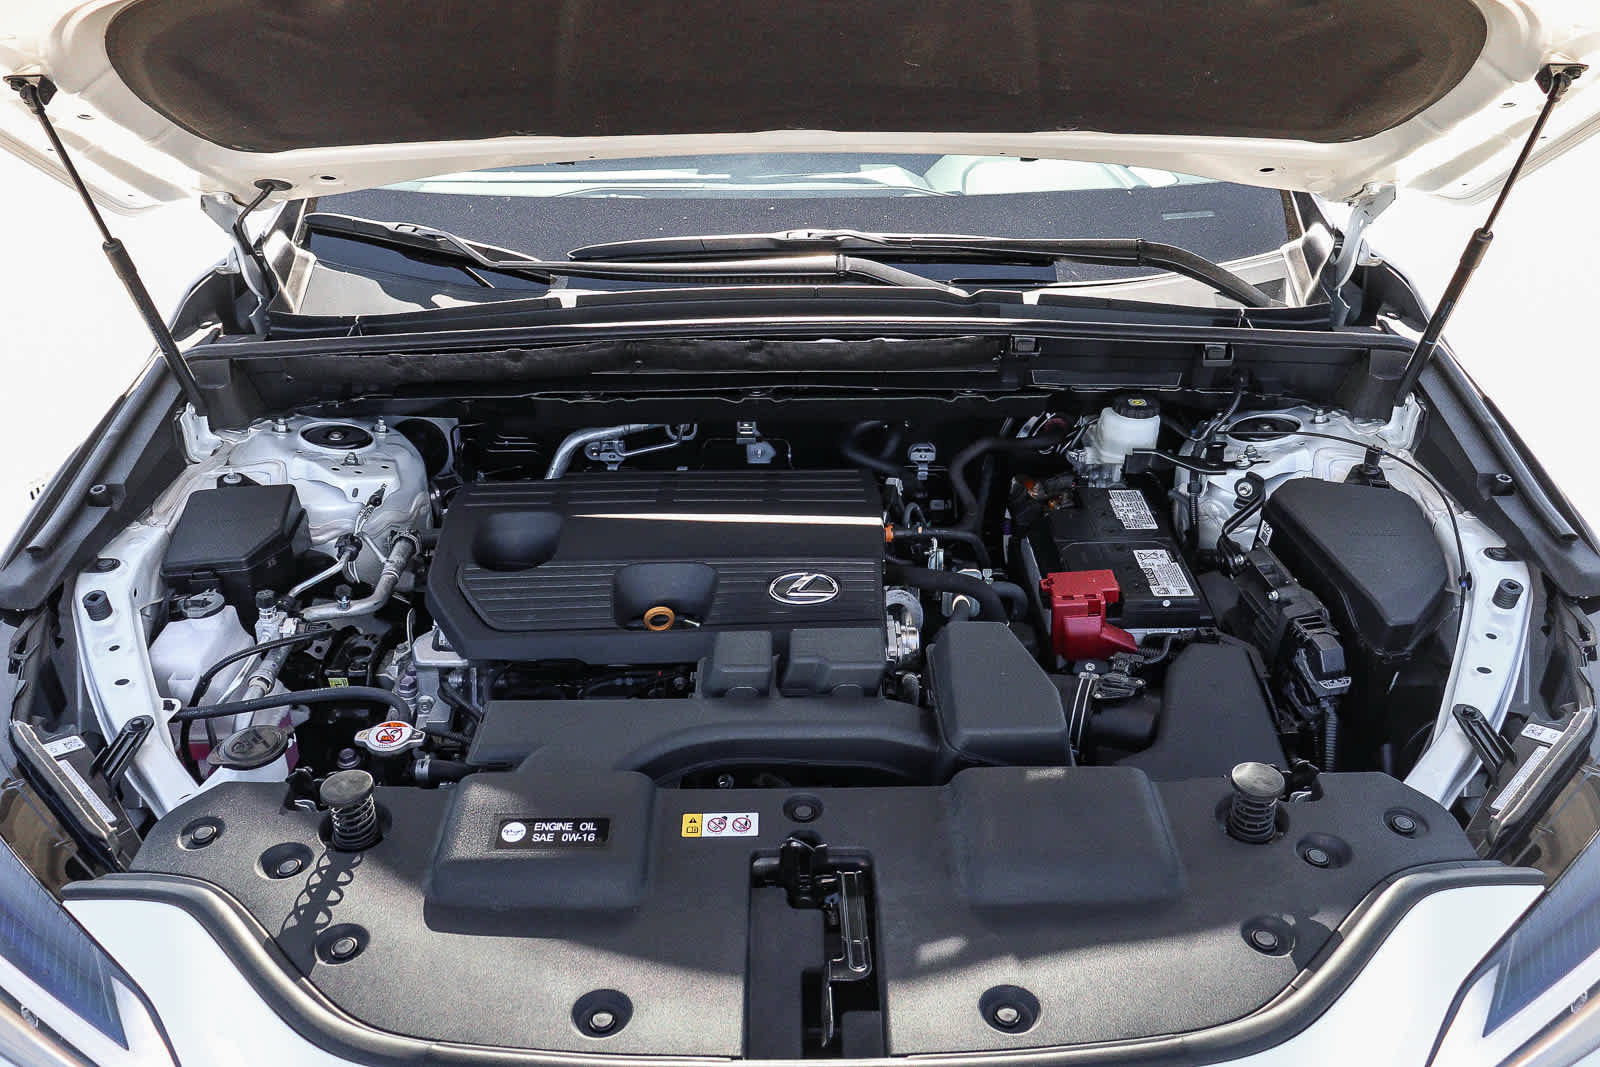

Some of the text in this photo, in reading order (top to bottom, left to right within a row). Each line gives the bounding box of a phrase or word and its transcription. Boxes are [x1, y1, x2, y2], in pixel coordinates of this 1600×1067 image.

[533, 822, 597, 831] ENGINE OIL
[532, 833, 596, 842] SAE 0W-16
